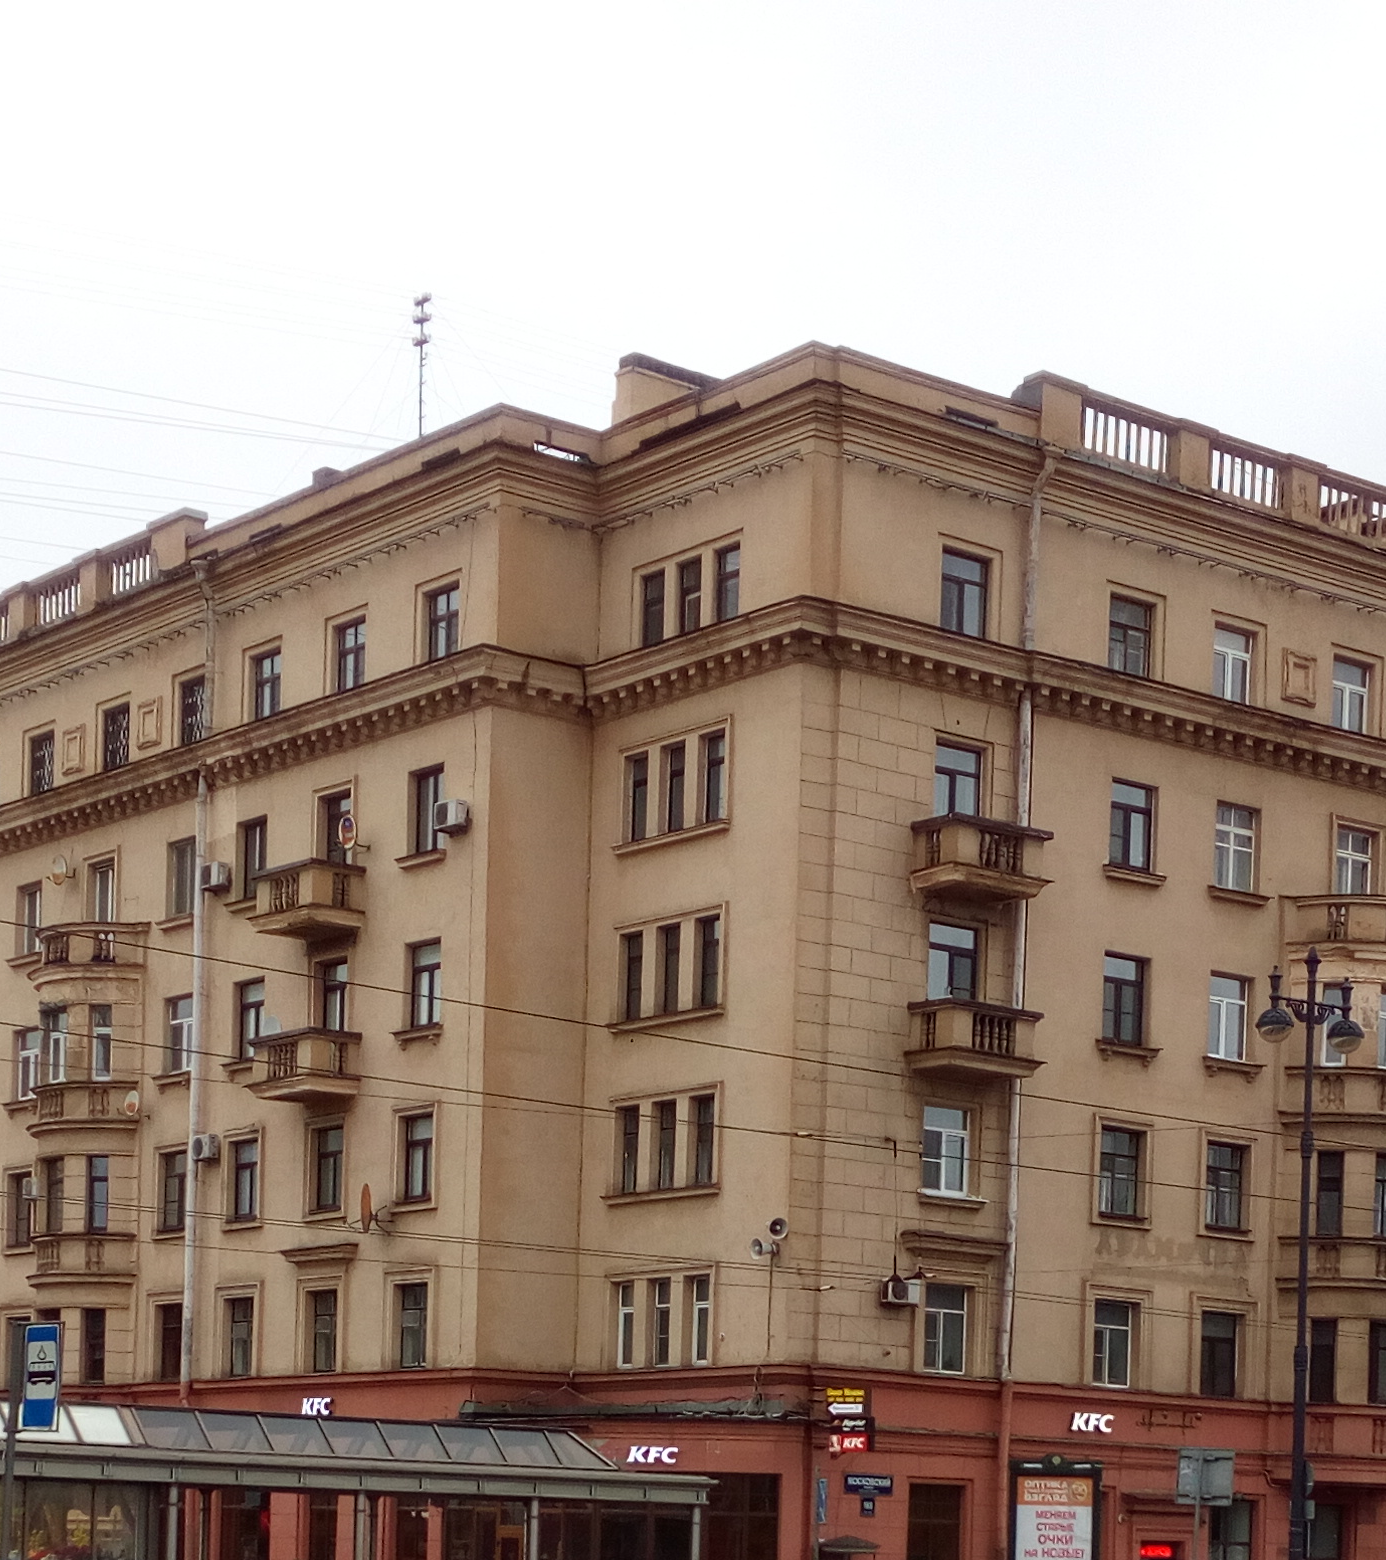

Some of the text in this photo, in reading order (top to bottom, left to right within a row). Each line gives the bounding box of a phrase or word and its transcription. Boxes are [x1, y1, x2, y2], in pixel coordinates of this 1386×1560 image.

[301, 1397, 332, 1416] KFC
[1070, 1411, 1115, 1433] KFC
[842, 1437, 865, 1449] KFC
[626, 1445, 679, 1465] KFC
[1035, 1510, 1077, 1520] МЕНЯЕМ
[1036, 1522, 1075, 1532] СТАРЫЕ
[1038, 1534, 1074, 1545] ОЧКИ
